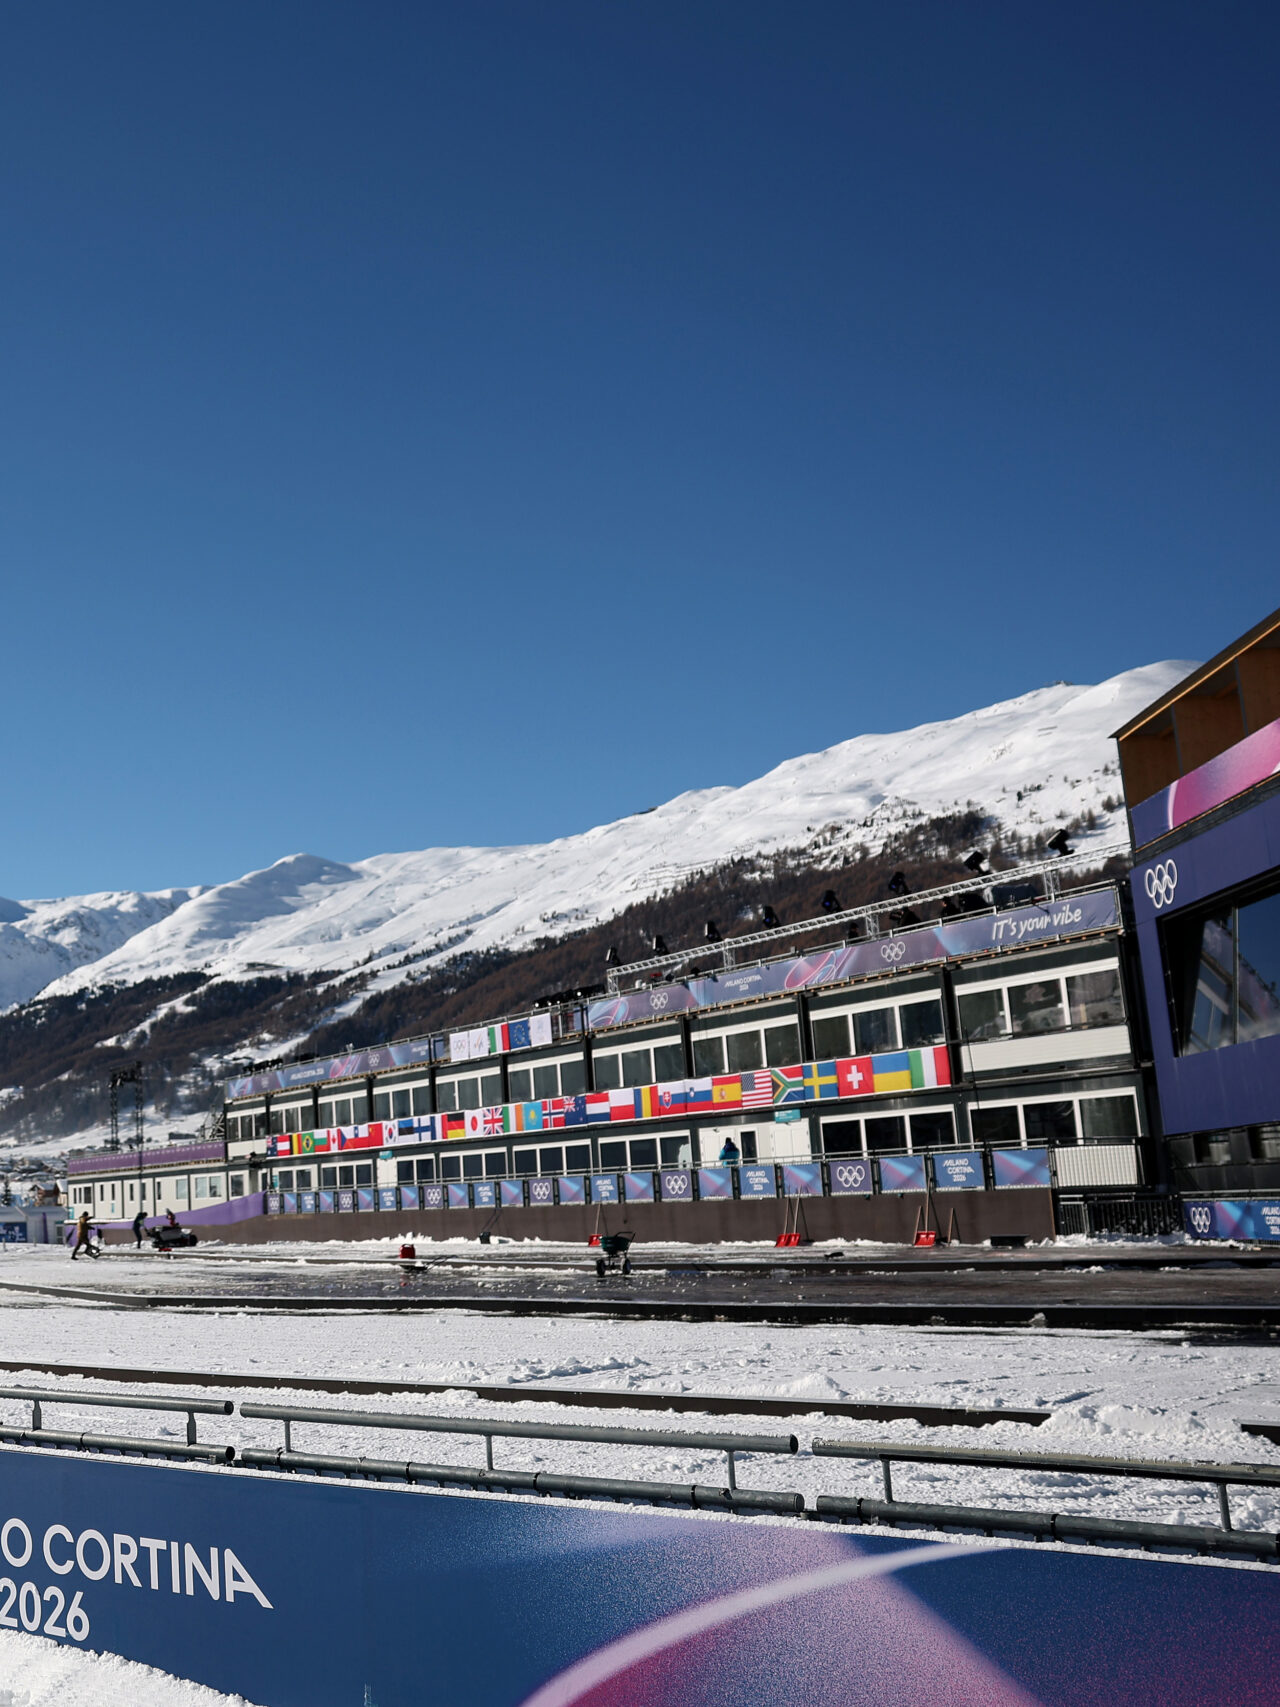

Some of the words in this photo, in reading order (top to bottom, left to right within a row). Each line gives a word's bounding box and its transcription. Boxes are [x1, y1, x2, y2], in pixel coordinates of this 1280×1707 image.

[1018, 914, 1052, 939] your
[1053, 904, 1082, 926] vibe
[943, 1158, 969, 1167] MILANO
[947, 1165, 975, 1174] CORTINA
[43, 1524, 274, 1609] CORTINA
